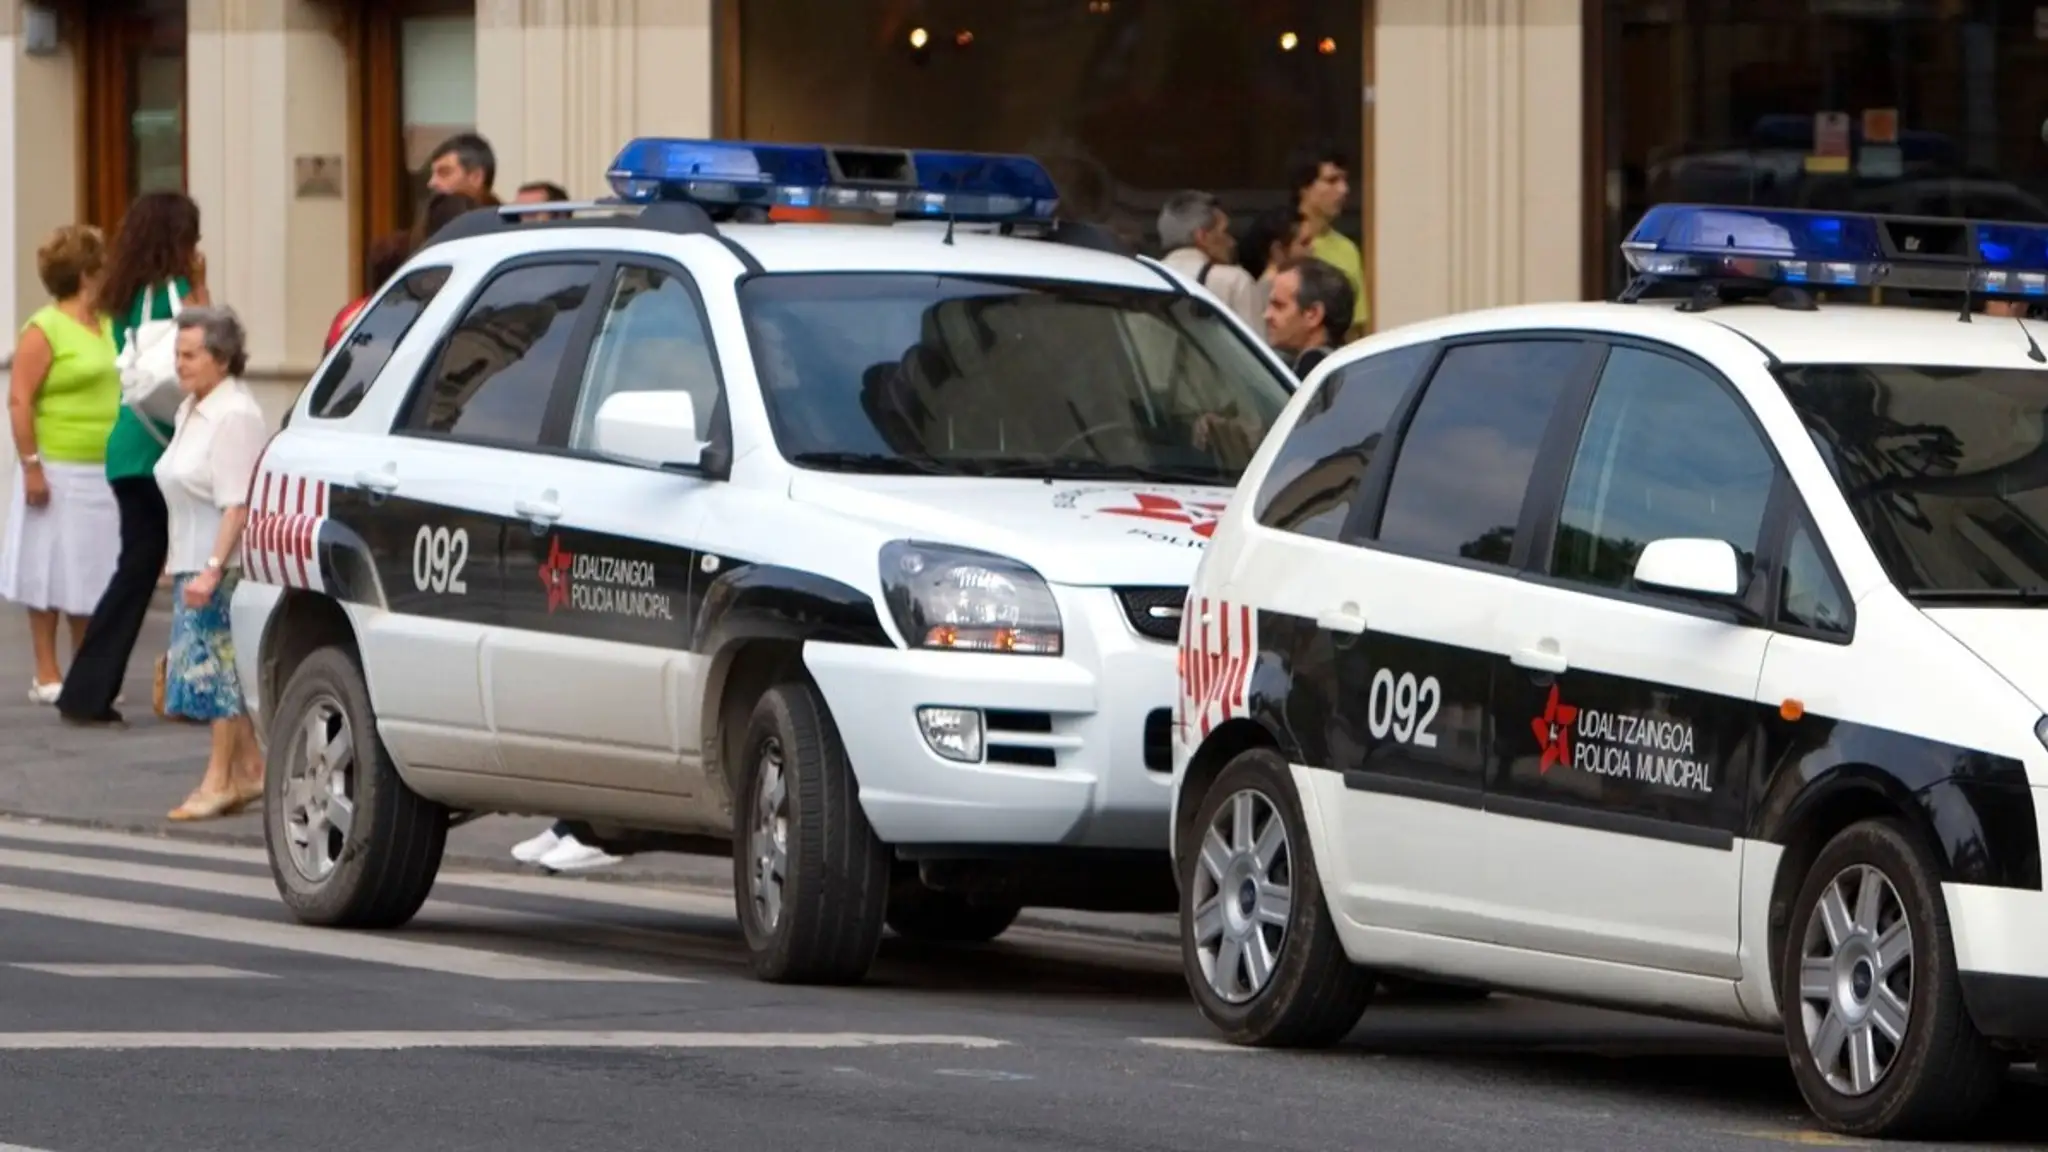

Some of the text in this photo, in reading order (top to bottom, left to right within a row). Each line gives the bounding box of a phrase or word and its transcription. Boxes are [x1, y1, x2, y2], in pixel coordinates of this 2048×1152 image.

[414, 525, 469, 594] 092
[572, 554, 655, 588] UDALTZAINGOA
[572, 583, 673, 620] POLICIA MUNICIPAL
[1368, 668, 1441, 748] 092
[1578, 709, 1694, 754] UDALTZAINGOA
[1574, 743, 1713, 793] POLICIA MUNICIPAL
